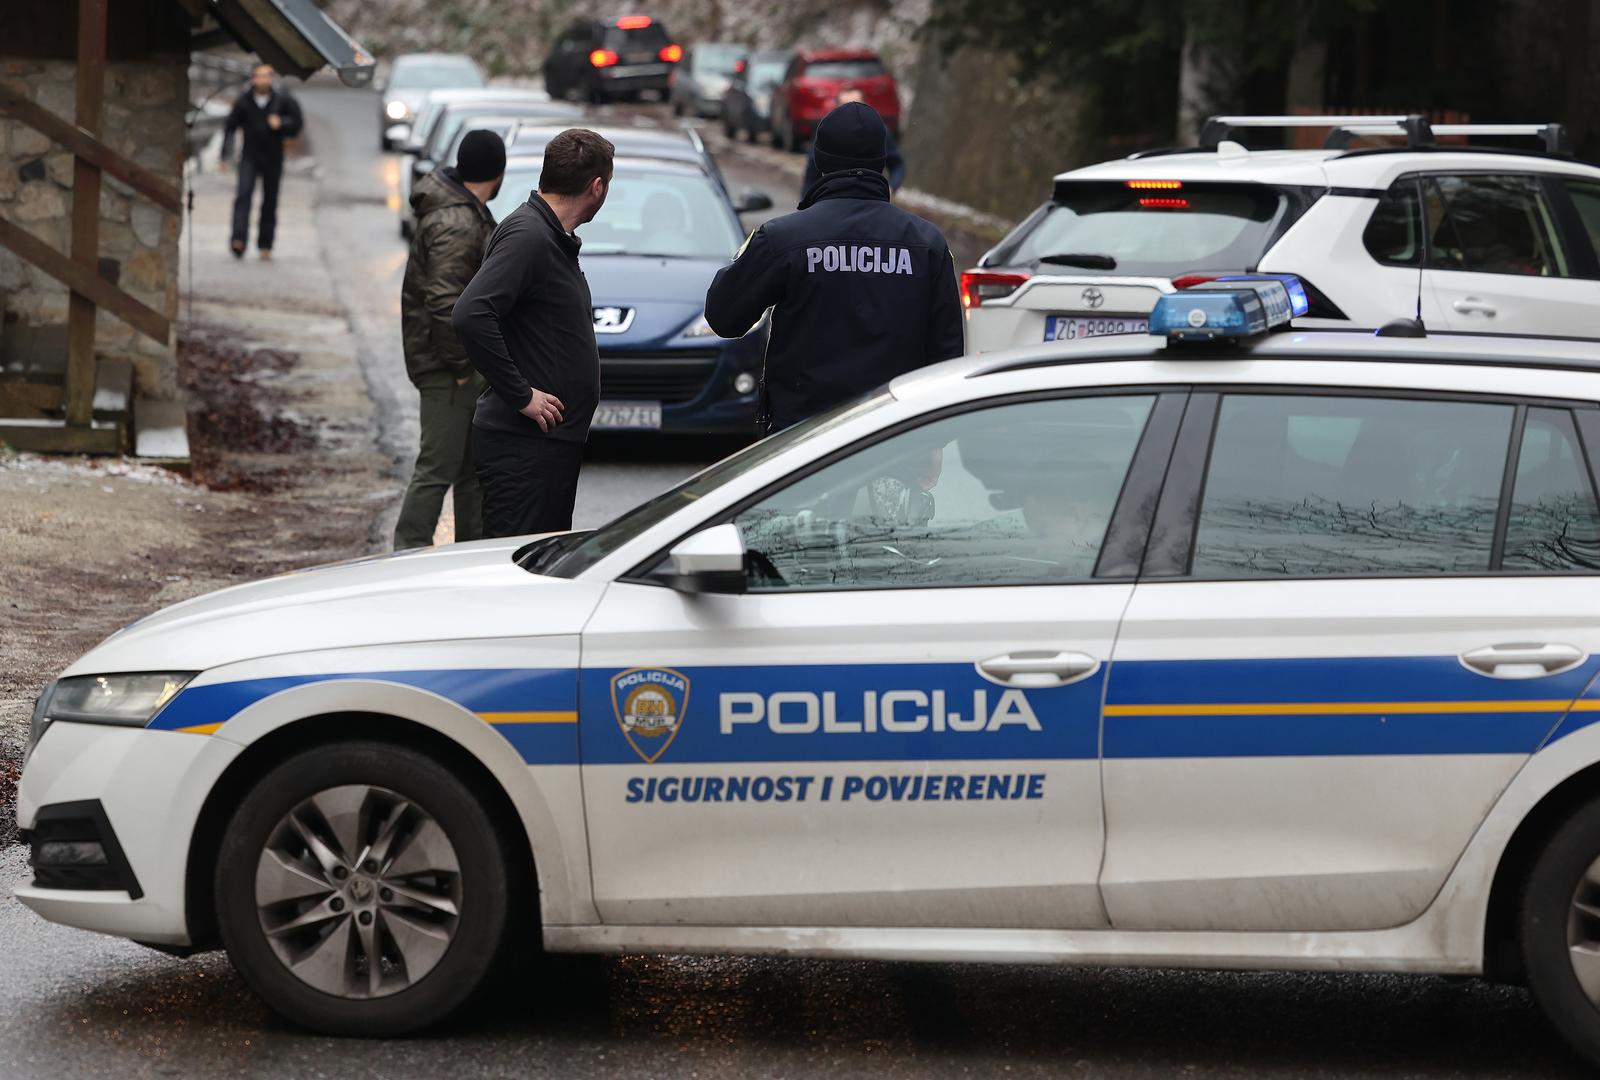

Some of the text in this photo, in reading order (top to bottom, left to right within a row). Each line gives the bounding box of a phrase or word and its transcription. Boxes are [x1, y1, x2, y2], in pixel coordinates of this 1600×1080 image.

[806, 245, 913, 275] POLICIJA
[617, 672, 685, 692] POLICIJA
[719, 689, 1043, 735] POLICIJA
[625, 774, 1046, 803] SIGURNOST I POVJERENJE
